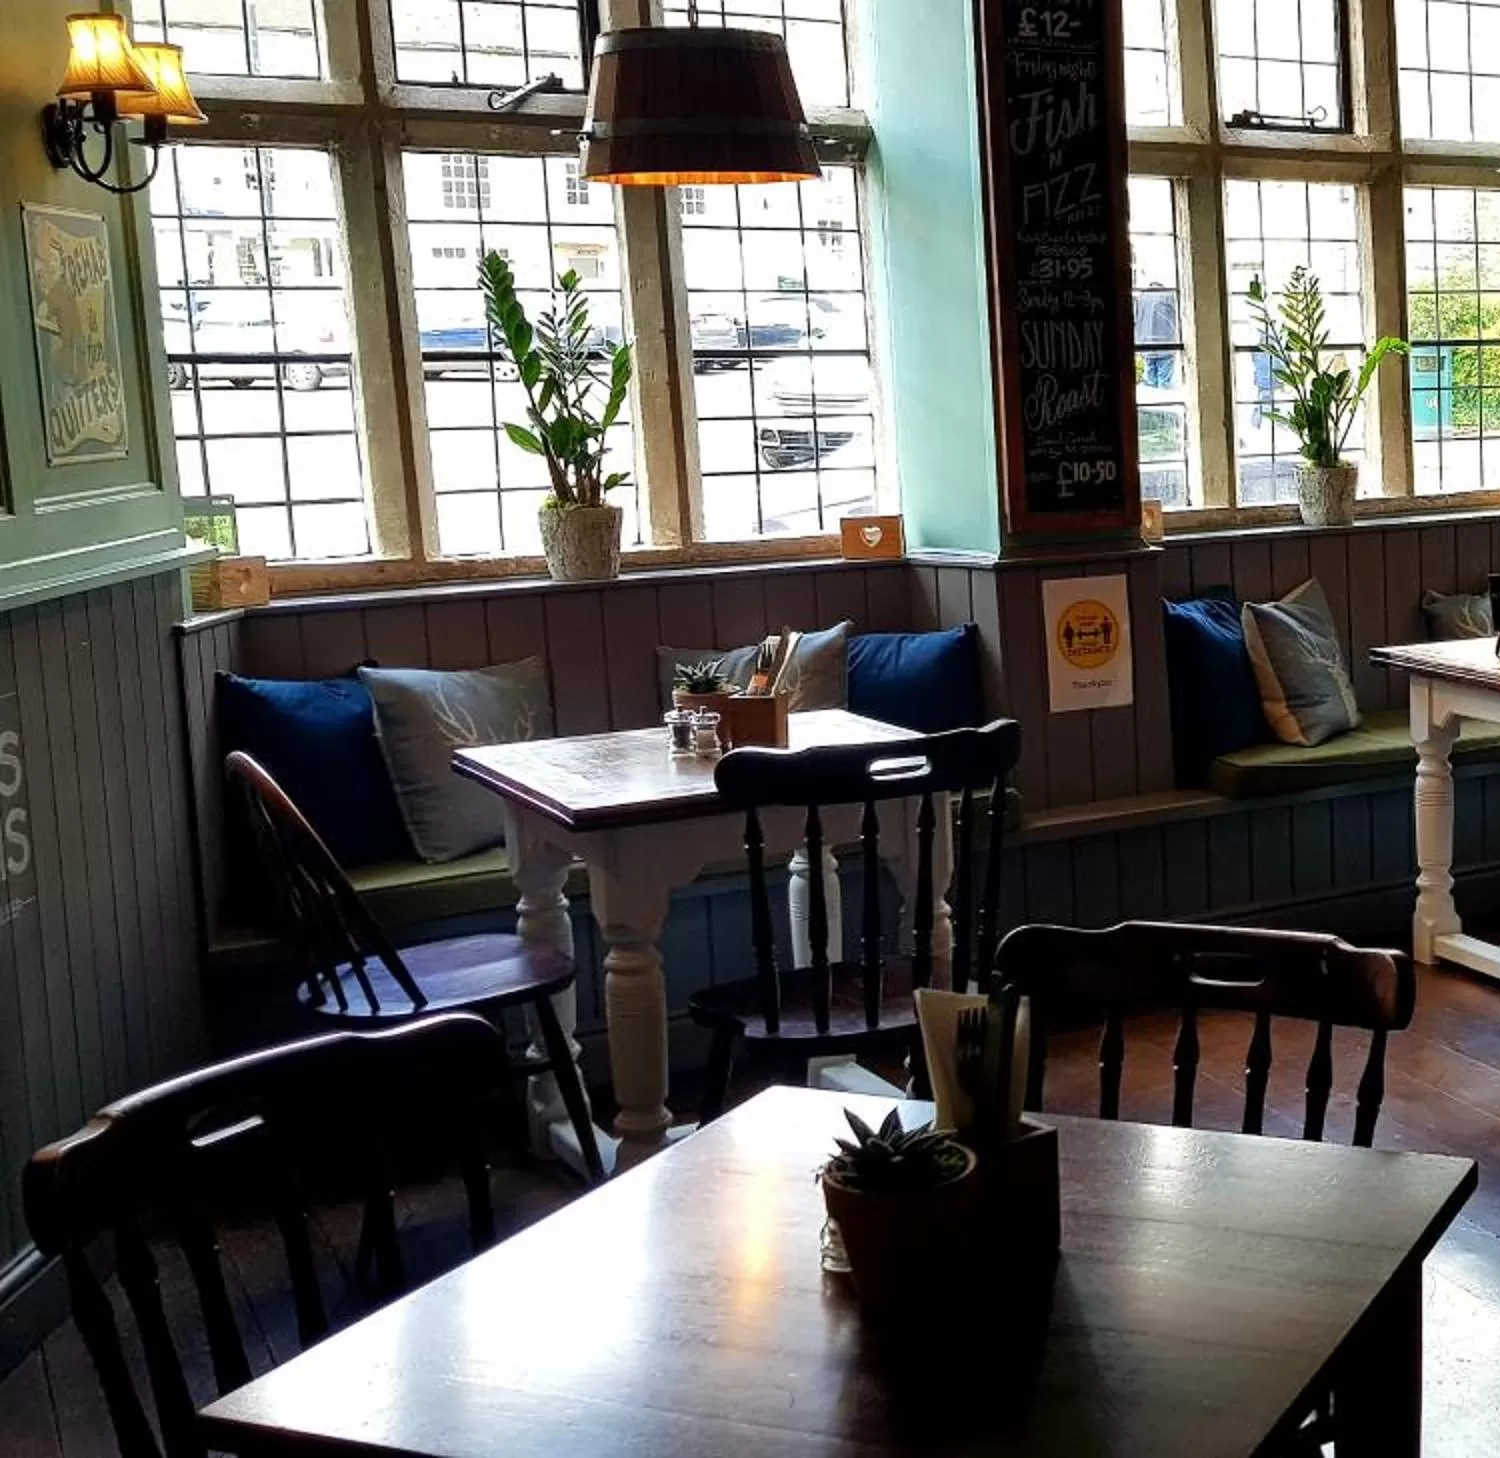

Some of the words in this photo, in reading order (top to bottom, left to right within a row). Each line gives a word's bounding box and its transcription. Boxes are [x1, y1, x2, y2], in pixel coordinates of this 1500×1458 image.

[1008, 80, 1098, 155] Fish
[1023, 161, 1102, 225] FIZZ
[1020, 319, 1105, 369] SUNDAY
[1024, 369, 1110, 432] Roast
